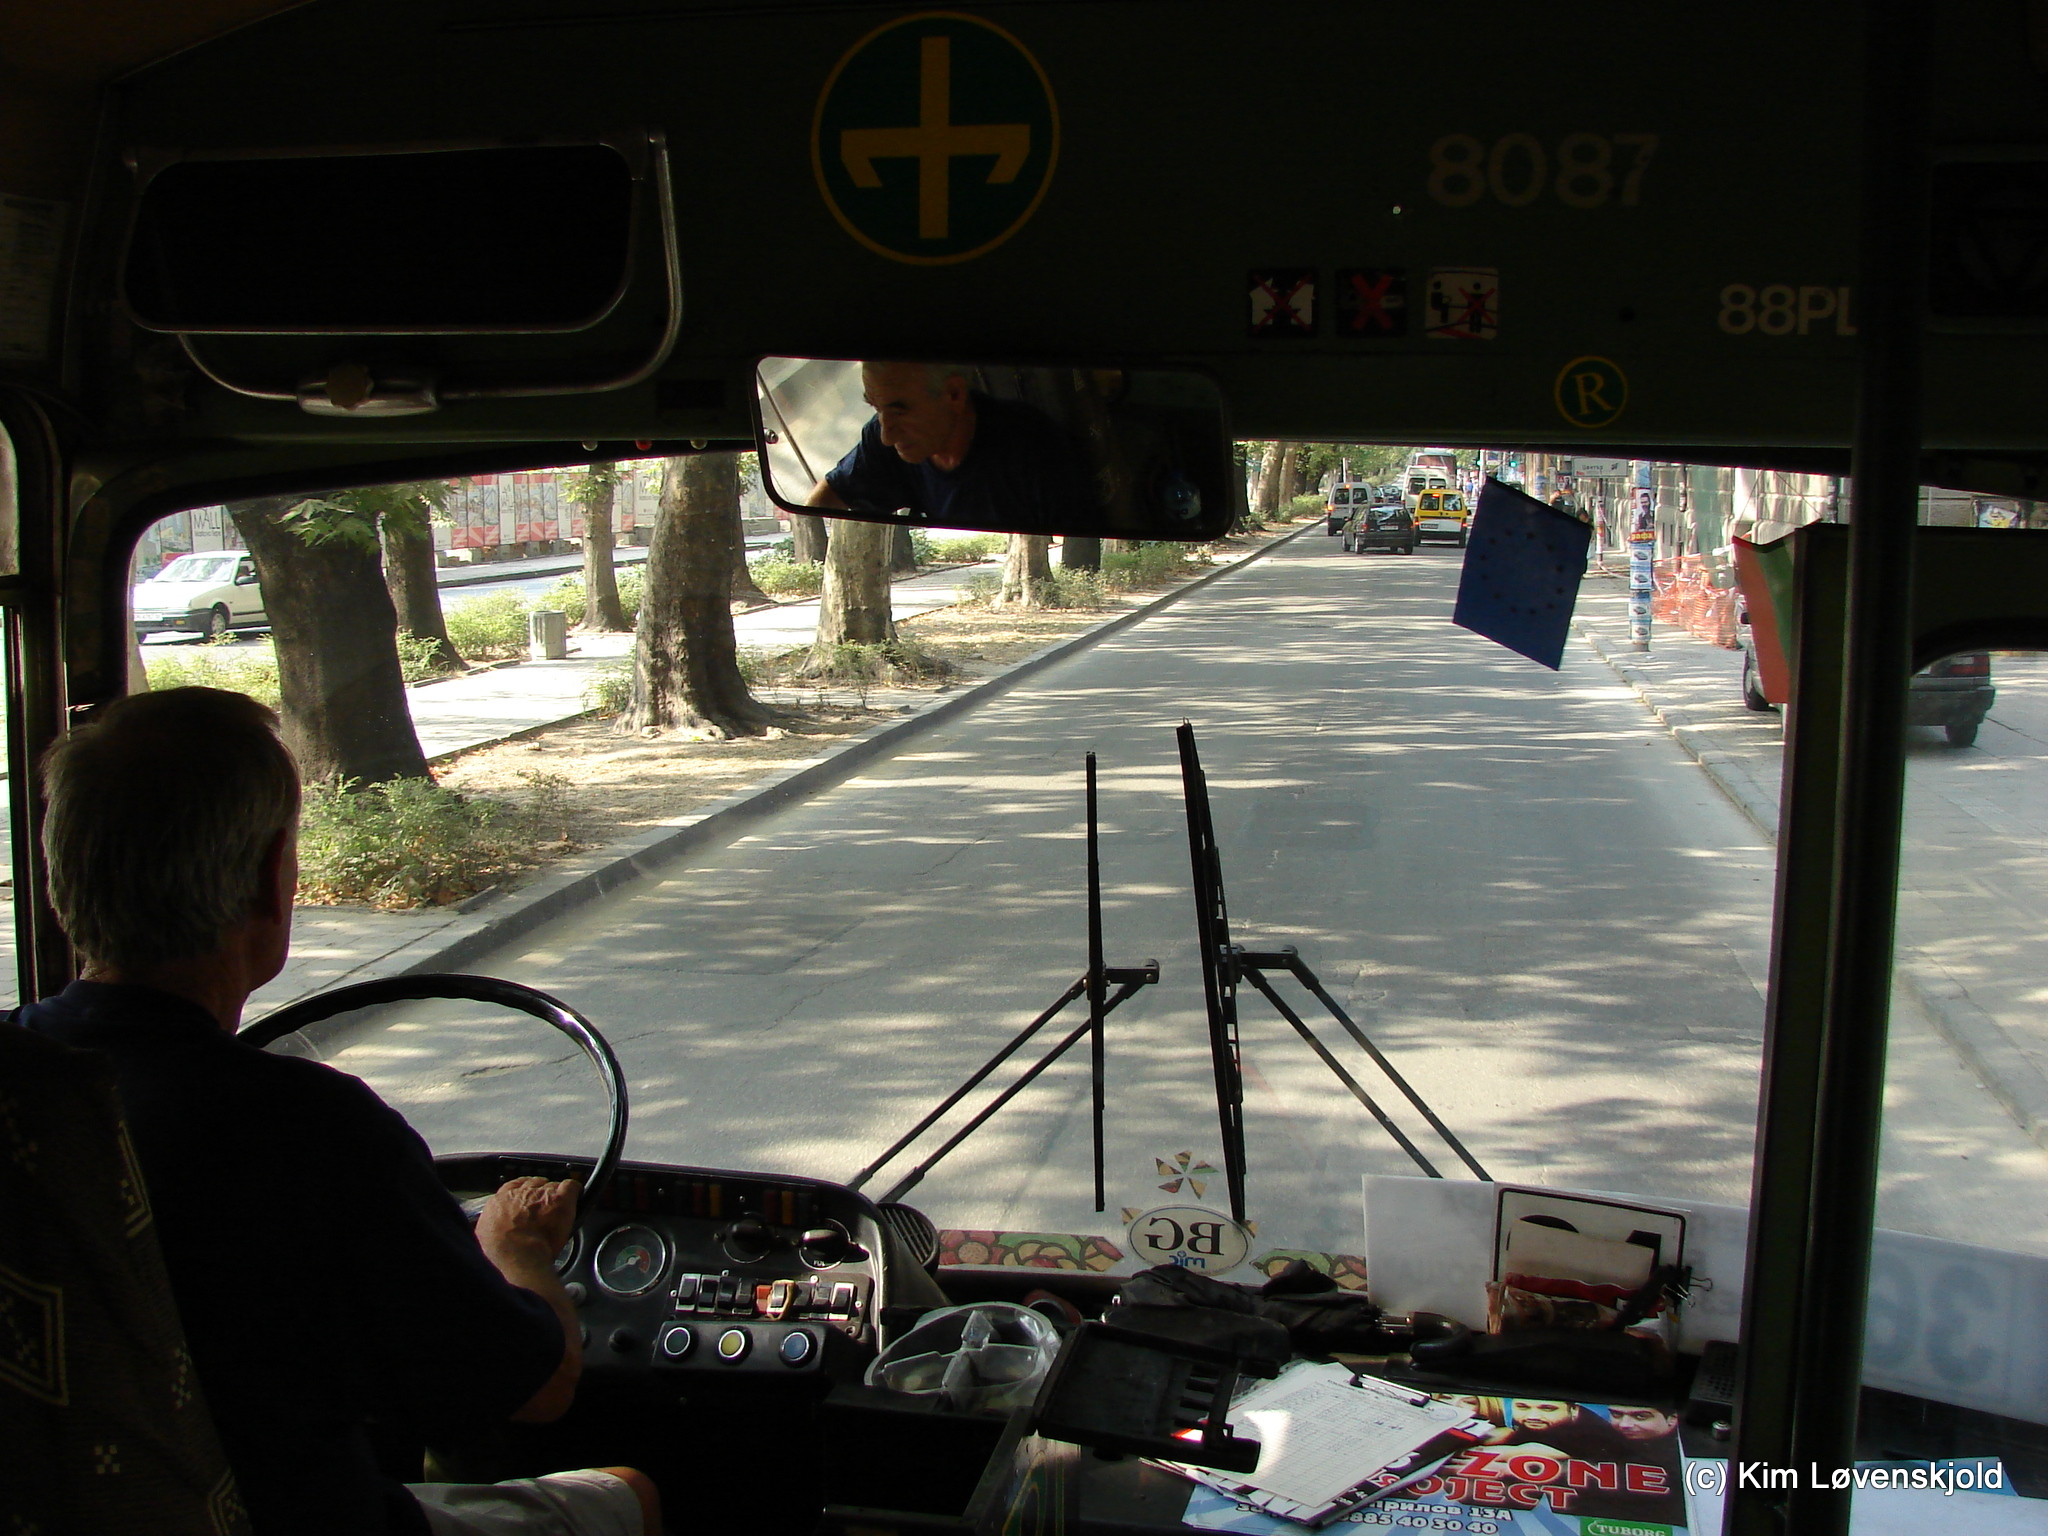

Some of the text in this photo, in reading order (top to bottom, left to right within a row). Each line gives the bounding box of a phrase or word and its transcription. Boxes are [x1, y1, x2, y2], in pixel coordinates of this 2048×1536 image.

[1426, 132, 1660, 209] 8087
[1457, 1450, 1671, 1494] ZONE
[1396, 1515, 1429, 1529] 40
[1431, 1517, 1464, 1532] 30
[1466, 1521, 1499, 1535] 40
[1596, 1523, 1667, 1536] TUBORG
